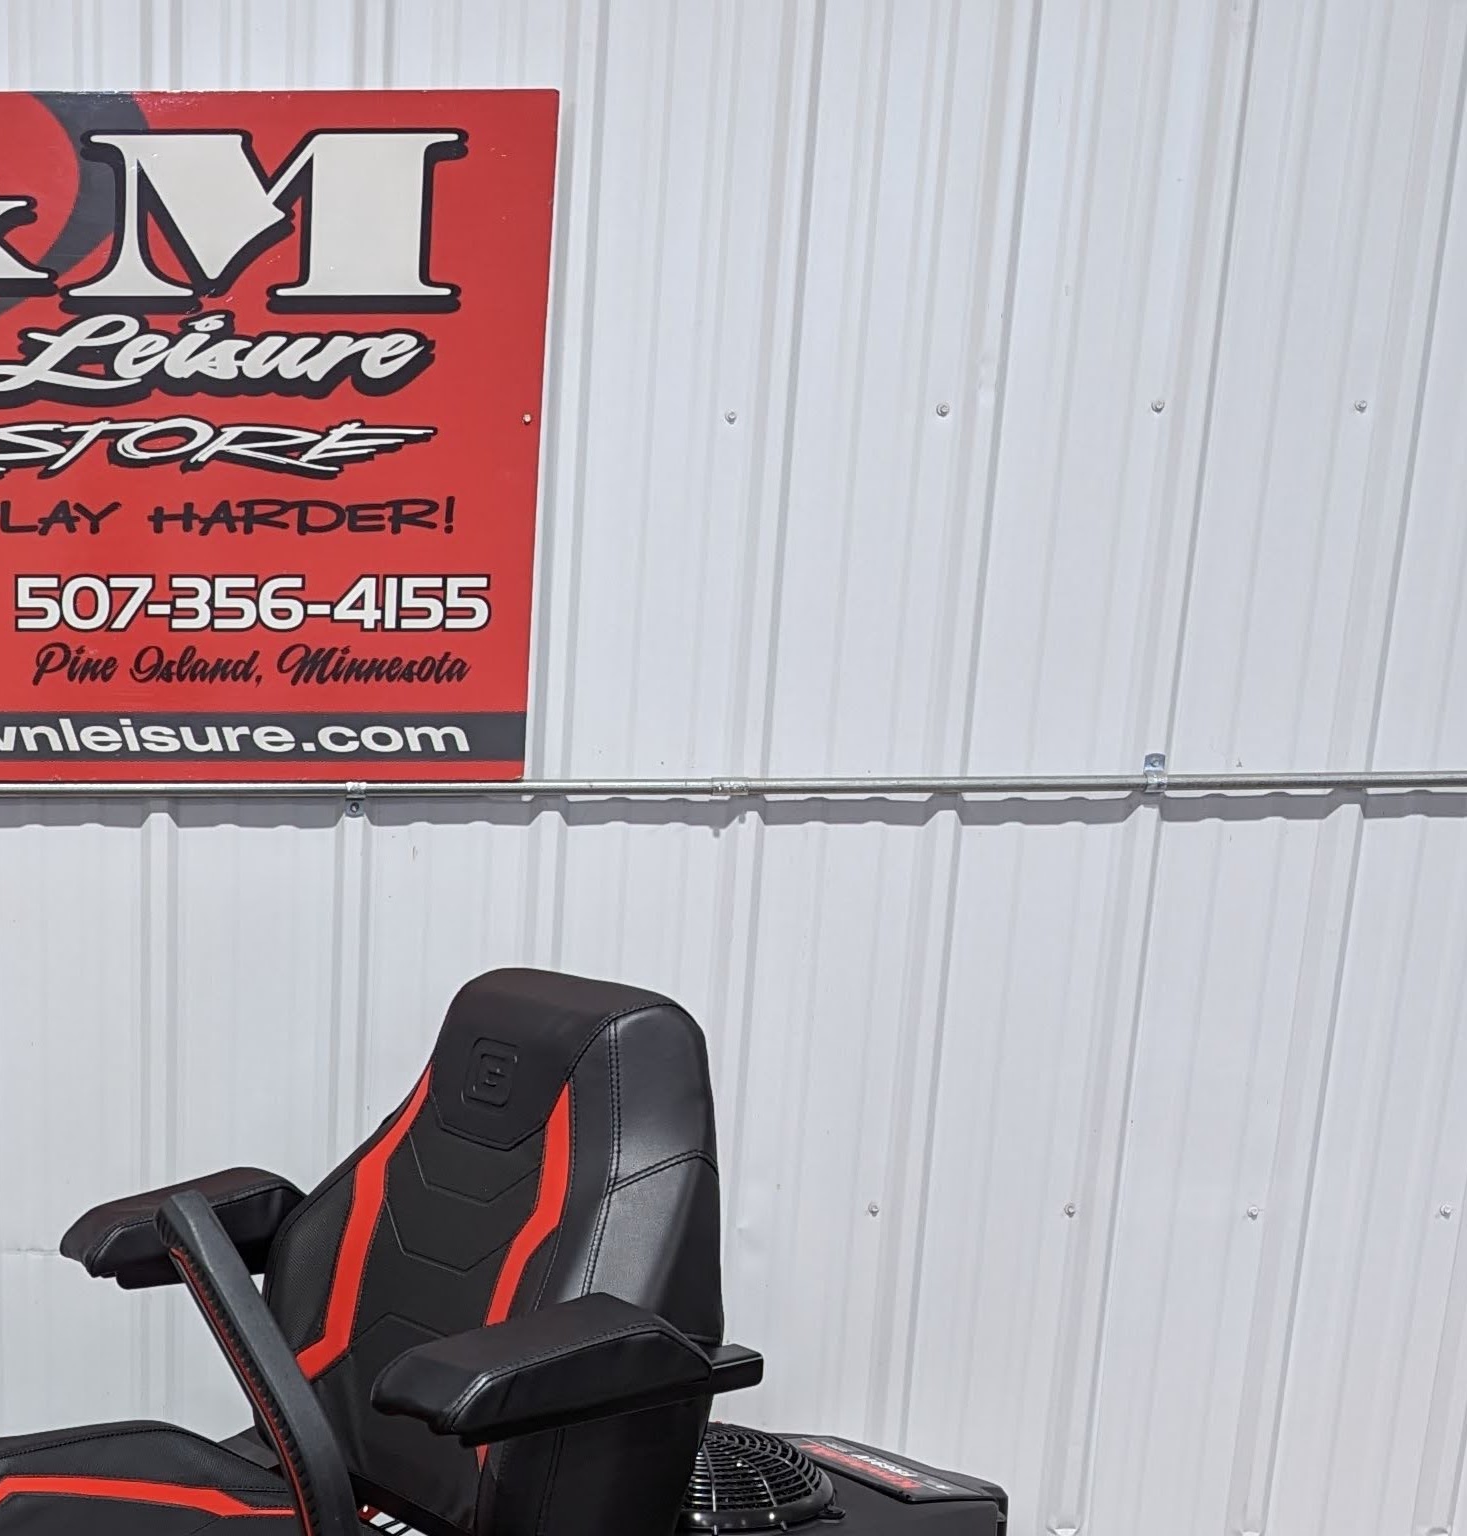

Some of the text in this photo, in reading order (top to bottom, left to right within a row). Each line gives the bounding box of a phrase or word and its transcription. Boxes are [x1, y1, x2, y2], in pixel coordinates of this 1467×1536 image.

[147, 495, 456, 536] HARDER!
[17, 575, 489, 631] 507-356-4155
[32, 641, 470, 687] Pine Island, Minnesota
